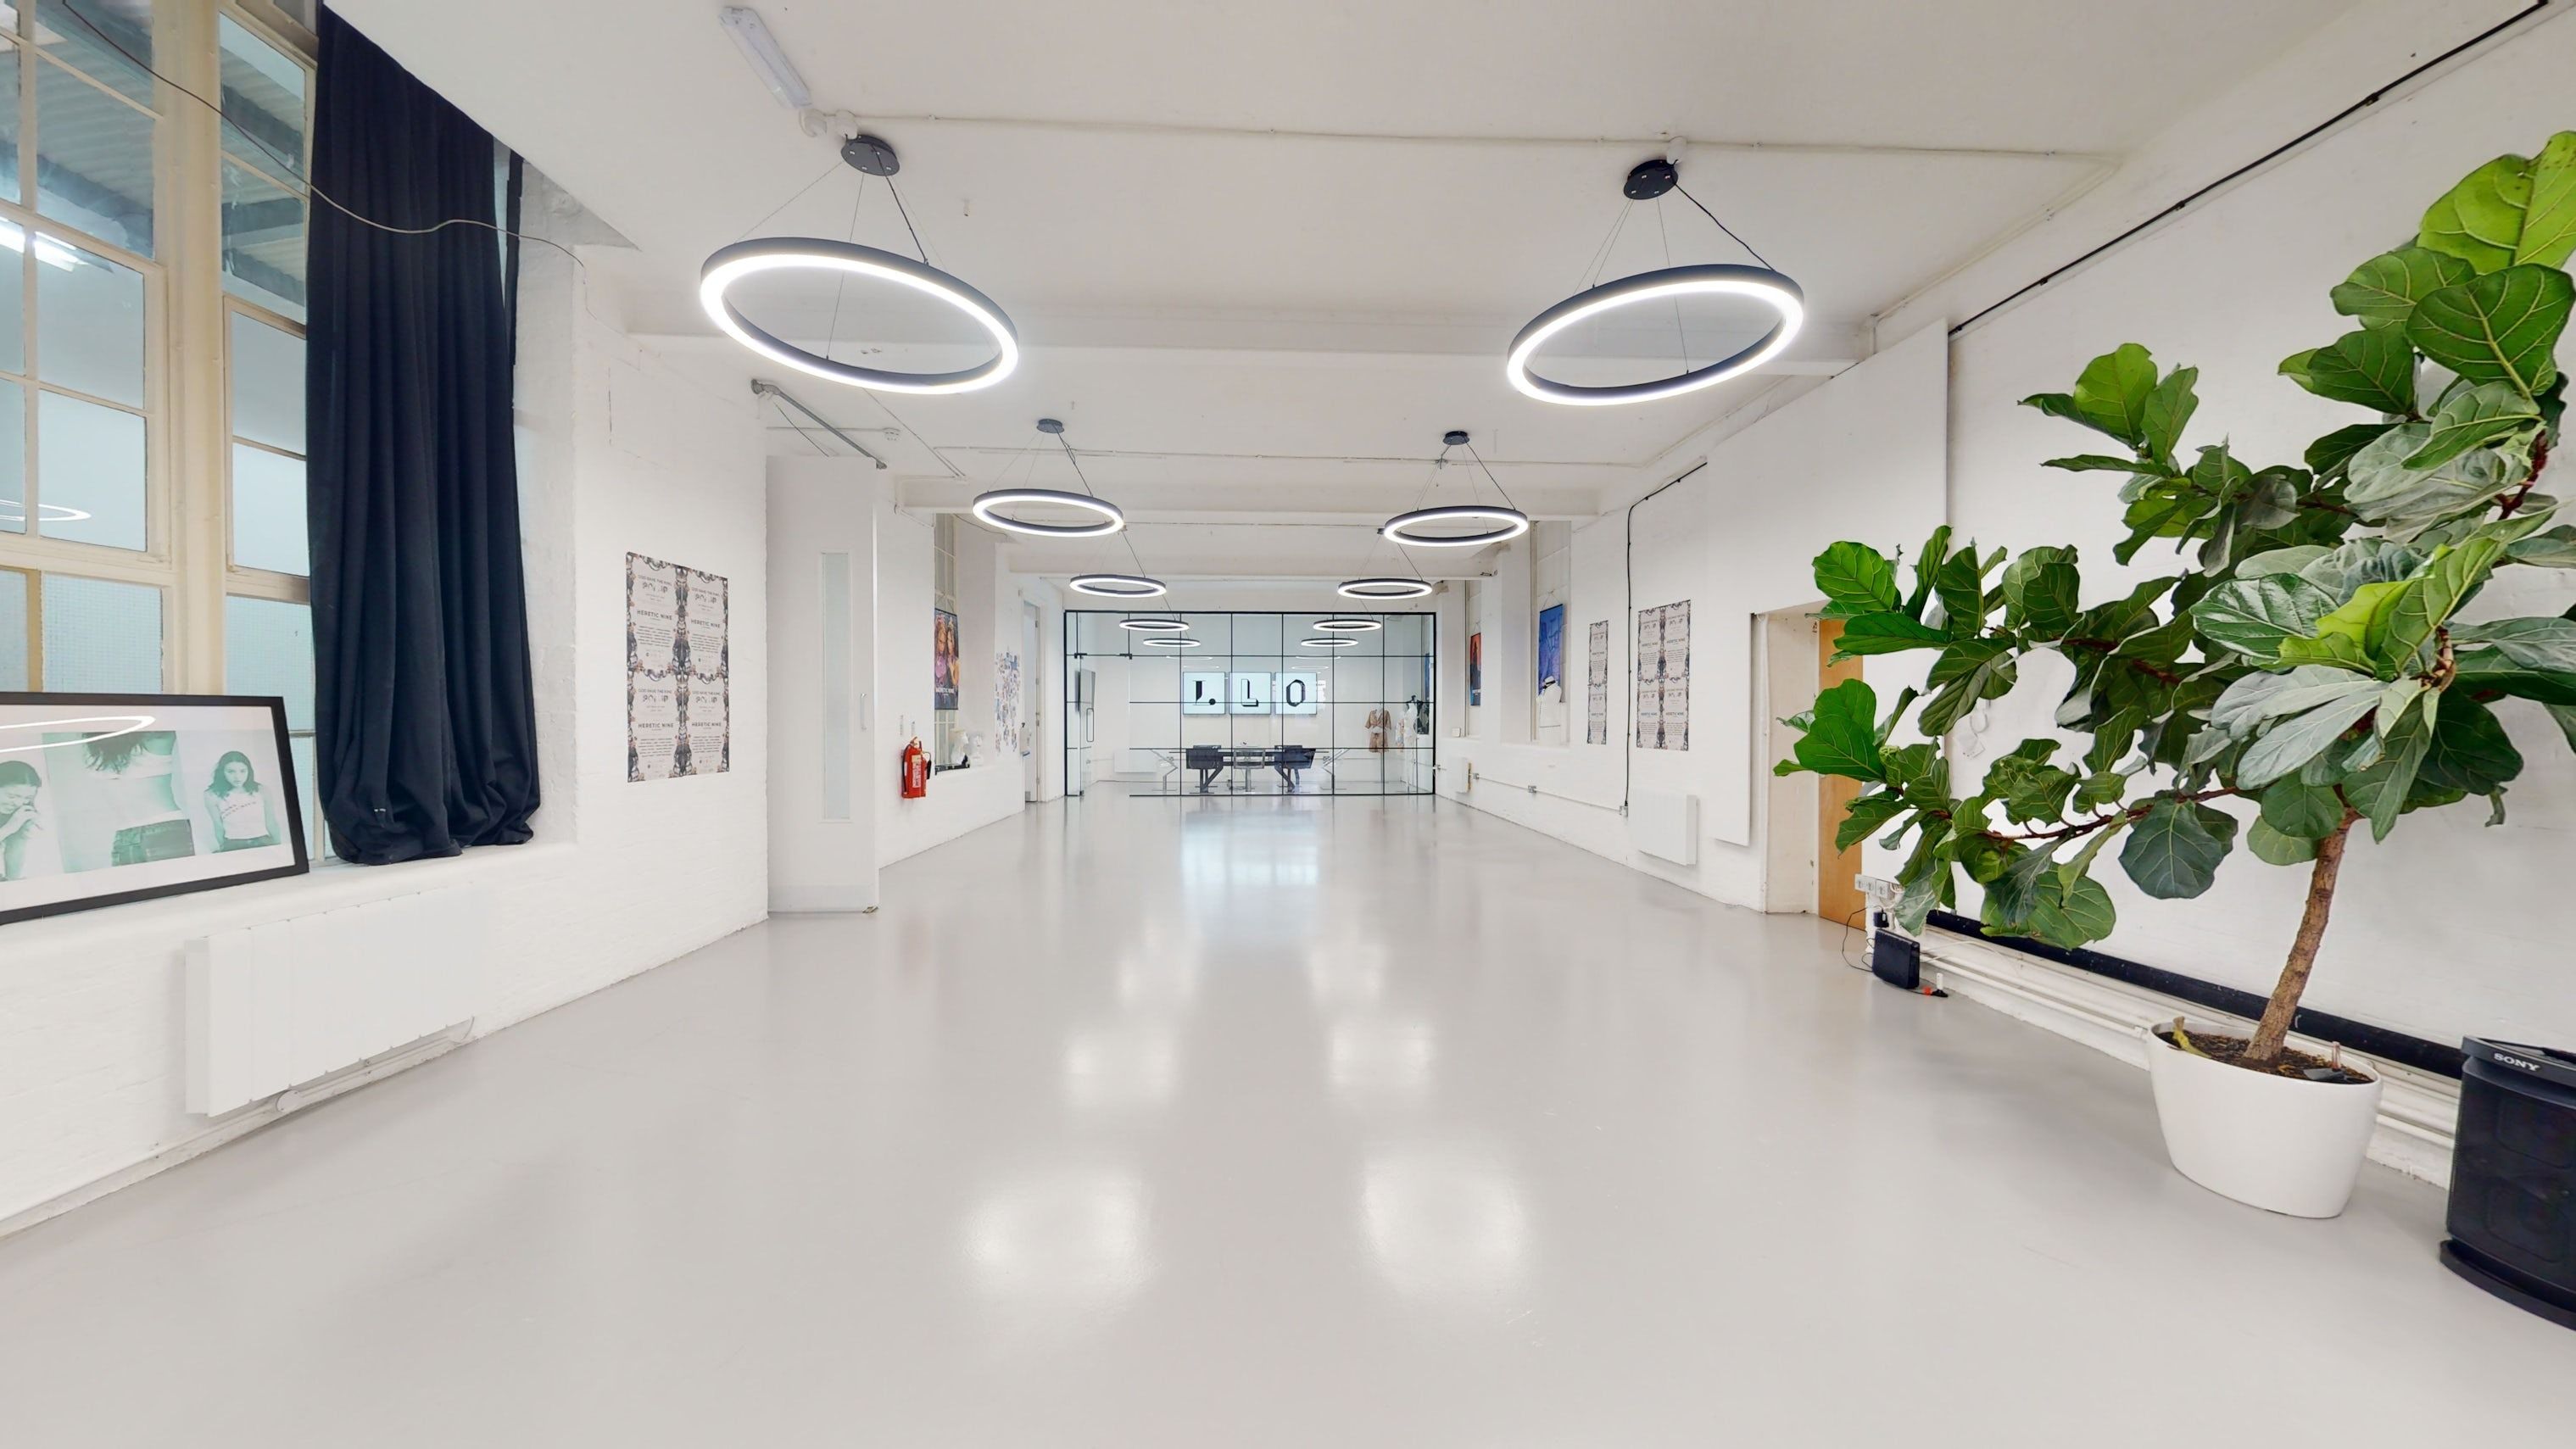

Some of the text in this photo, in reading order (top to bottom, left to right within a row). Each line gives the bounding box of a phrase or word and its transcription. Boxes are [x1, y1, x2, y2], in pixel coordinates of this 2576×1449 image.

[637, 610, 659, 618] HERETIC
[1241, 679, 1259, 707] L
[1285, 679, 1306, 707] O
[2494, 1052, 2540, 1072] SONY
